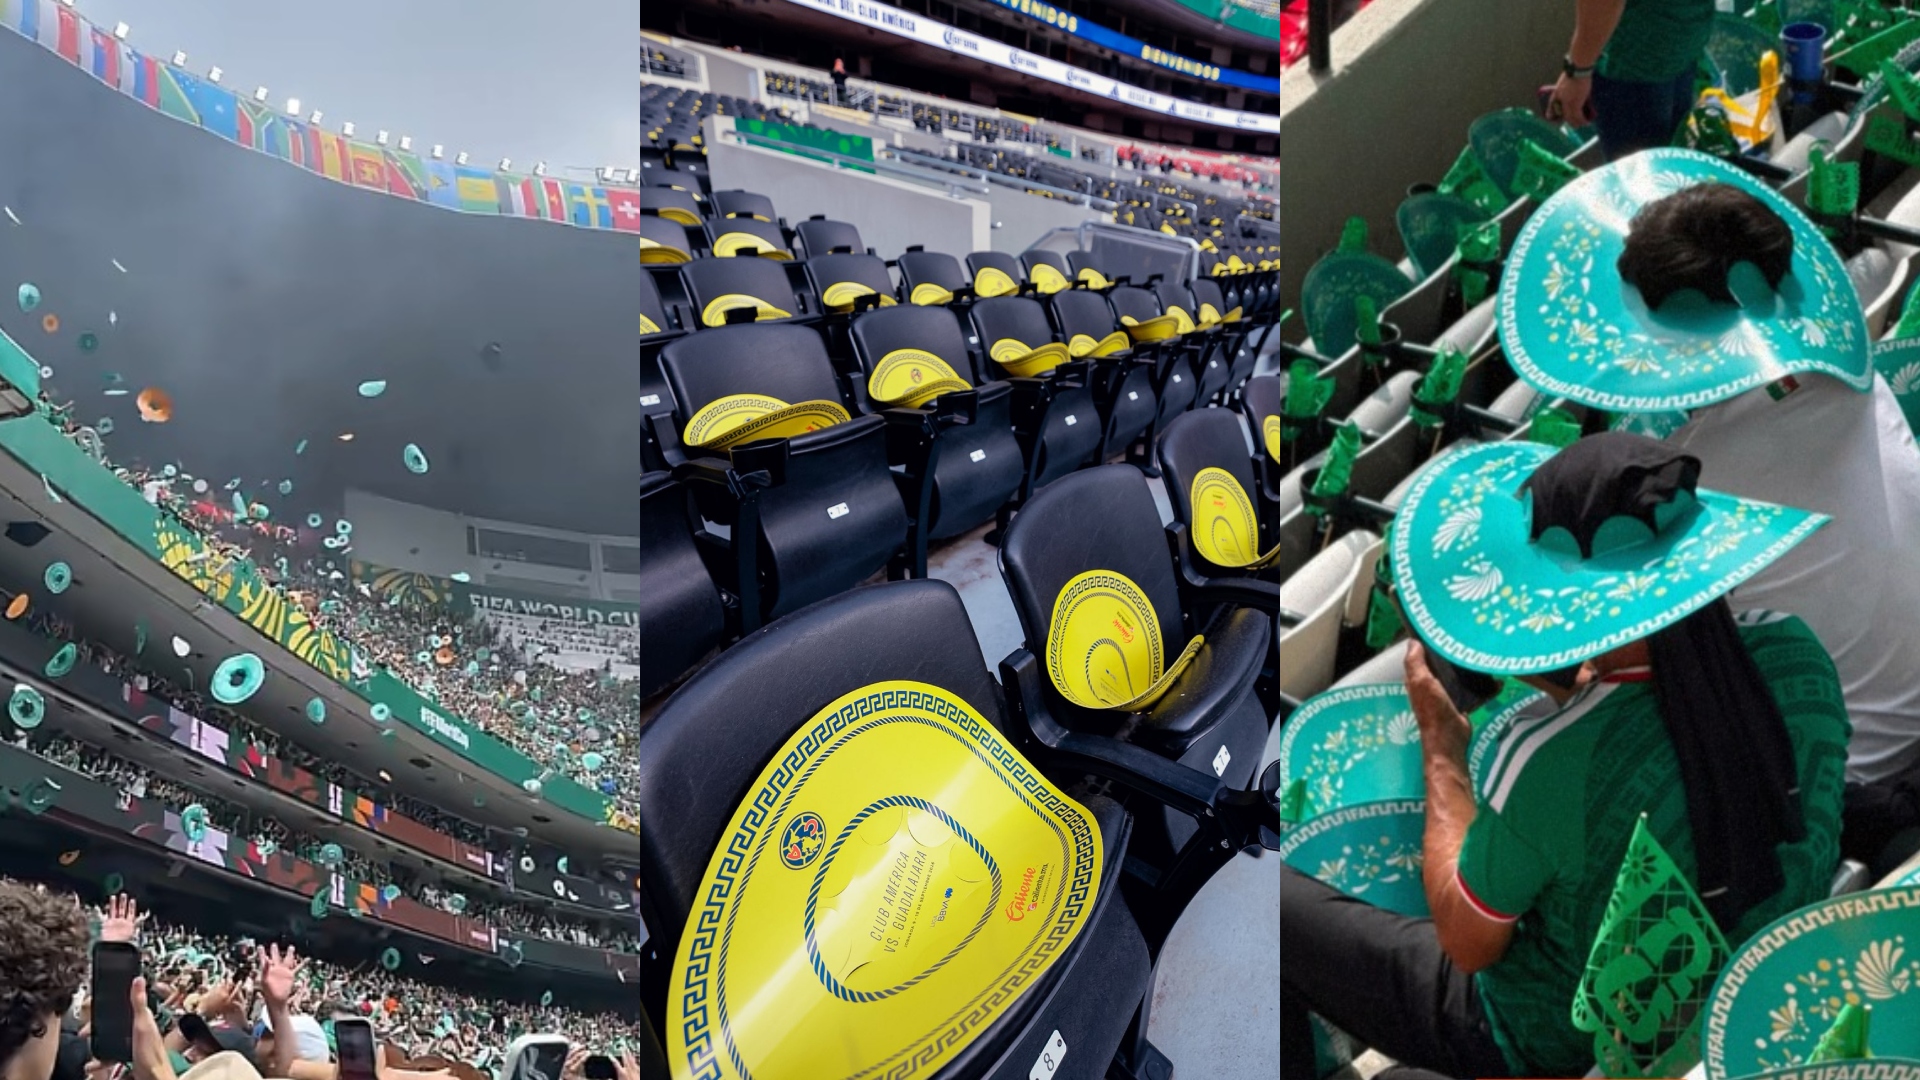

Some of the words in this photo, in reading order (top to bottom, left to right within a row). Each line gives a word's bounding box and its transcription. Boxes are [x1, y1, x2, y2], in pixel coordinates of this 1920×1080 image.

[859, 4, 878, 20] CLUB
[1141, 44, 1220, 81] BIENVENIDOS
[469, 593, 513, 612] FIFA
[1335, 803, 1370, 826] FIFA
[869, 907, 890, 942] CLUB
[883, 851, 910, 907] AMÉRICA
[883, 936, 901, 953] VS.
[892, 850, 928, 932] GUADALAJARA
[1005, 867, 1036, 923] Caliente
[937, 899, 950, 922] BBVA
[1823, 896, 1871, 924] FIFA
[1733, 943, 1771, 980] FIFA
[1043, 1052, 1055, 1072] 8
[1707, 1034, 1725, 1068] FIFA
[1802, 1065, 1851, 1080] FIFA
